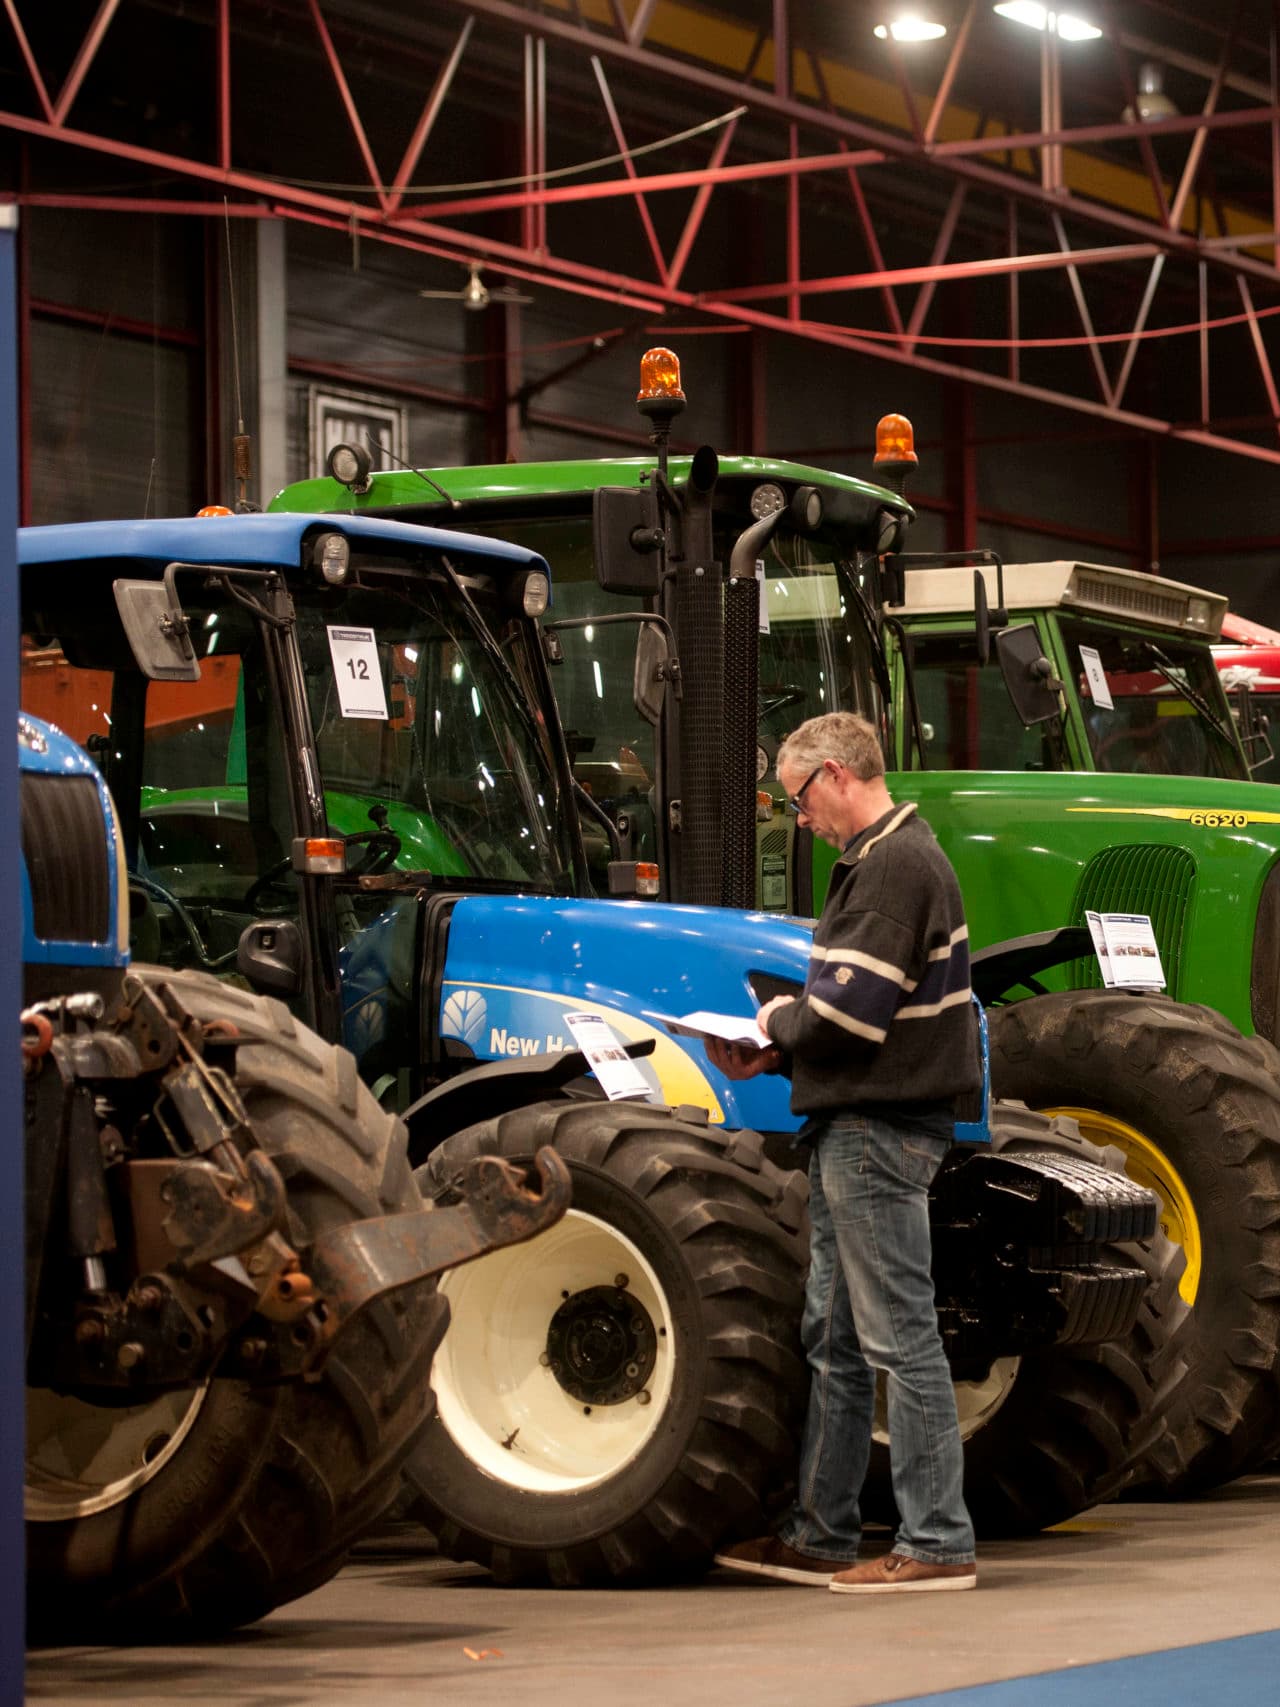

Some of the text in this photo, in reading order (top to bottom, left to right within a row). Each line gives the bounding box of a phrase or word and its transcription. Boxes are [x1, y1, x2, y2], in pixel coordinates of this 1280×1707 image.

[346, 658, 370, 680] 12
[1190, 812, 1248, 828] 6620
[490, 1028, 540, 1057] New
